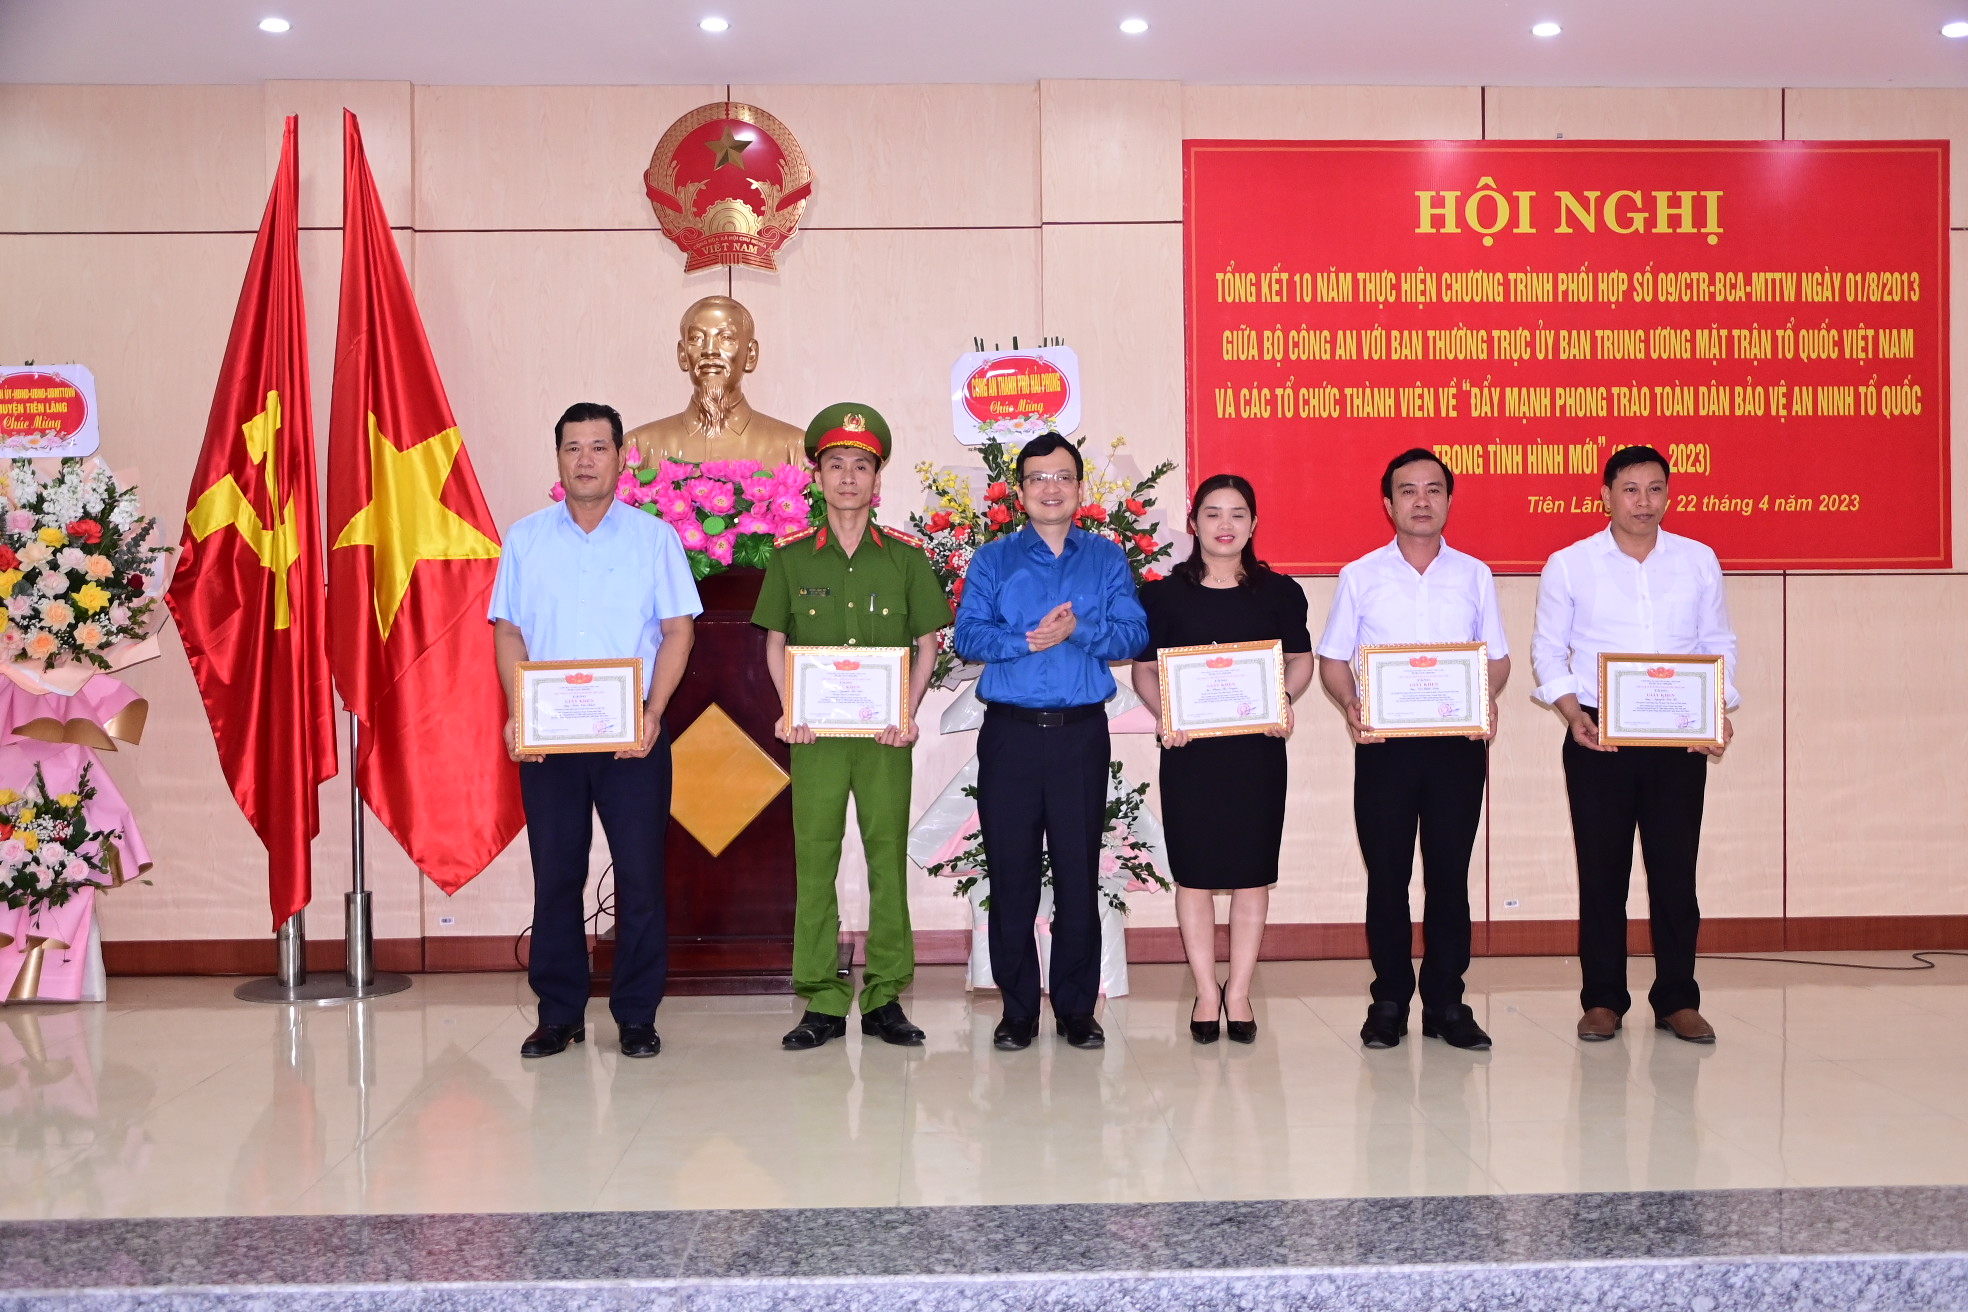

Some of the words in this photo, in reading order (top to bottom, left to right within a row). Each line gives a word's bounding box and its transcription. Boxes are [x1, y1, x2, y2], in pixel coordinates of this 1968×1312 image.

[1414, 176, 1537, 247] HỘI
[1554, 189, 1724, 246] NGHỊ
[733, 242, 759, 254] NAM
[1215, 260, 1257, 304] TỔNG
[1260, 262, 1290, 303] KẾT
[1293, 272, 1313, 303] 10
[1316, 265, 1353, 303] NĂM
[1356, 269, 1397, 309] THỰC
[1400, 265, 1437, 309] HIỆN
[1441, 269, 1504, 303] CHƯƠNG
[1507, 265, 1554, 303] TRÌNH
[1557, 261, 1594, 303] PHỐI
[1597, 269, 1629, 309] HỢP
[1632, 261, 1654, 303] SỐ
[1657, 271, 1797, 303] 09/CTR-BCA-MTTW
[1801, 265, 1842, 303] NGÀY
[1845, 271, 1920, 303] 01/8/2013
[1222, 323, 1259, 361] GIỮA
[1263, 323, 1284, 368] BỘ
[1288, 323, 1331, 361] CÔNG
[1335, 329, 1357, 361] AN
[1360, 323, 1387, 361] VỚI
[1390, 329, 1423, 360] BAN
[1426, 322, 1488, 361] THƯỜNG
[1491, 326, 1531, 367] TRỰC
[1535, 319, 1555, 361] ỦY
[1559, 329, 1591, 360] BAN
[1594, 329, 1645, 360] TRUNG
[1649, 326, 1691, 360] ƯƠNG
[1695, 322, 1728, 366] MẶT
[1731, 322, 1772, 366] TRẬN
[1775, 316, 1795, 360] TỔ
[1798, 318, 1839, 363] QUỐC
[1842, 322, 1875, 366] VIỆT
[1878, 328, 1914, 359] NAM
[971, 374, 989, 397] CÔNG
[988, 375, 998, 396] AN
[997, 372, 1018, 395] THÀNH
[1017, 367, 1031, 395] PHỐ
[1030, 365, 1041, 393] HẢI
[1040, 368, 1062, 392] PHÒNG
[26, 400, 45, 414] TIÊN
[46, 400, 68, 413] LÃNG
[990, 400, 1015, 414] Chúc
[1014, 399, 1044, 413] Mừng
[1214, 381, 1236, 419] VÀ
[1239, 381, 1271, 419] CÁC
[1274, 375, 1295, 419] TỔ
[1298, 380, 1340, 419] CHỨC
[1344, 380, 1395, 418] THÀNH
[1399, 380, 1435, 418] VIÊN
[1438, 377, 1458, 418] VỀ
[1505, 386, 1551, 424] MẠNH
[1555, 386, 1608, 418] PHONG
[1611, 380, 1651, 417] TRÀO
[1654, 379, 1695, 417] TOÀN
[1698, 379, 1730, 416] DÂN
[1734, 375, 1765, 417] BẢO
[1768, 379, 1788, 423] VỆ
[1791, 386, 1813, 416] AN
[1817, 386, 1855, 416] NINH
[1858, 373, 1877, 416] TỔ
[1881, 374, 1922, 419] QUỐC
[4, 415, 30, 429] Chúc
[30, 414, 62, 430] Mừng
[1432, 443, 1484, 475] TRONG
[1487, 437, 1523, 475] TÌNH
[1527, 437, 1564, 475] HÌNH
[1668, 443, 1711, 476] 2023)
[1527, 495, 1564, 513] Tiên
[1676, 494, 1697, 512] 22
[1702, 494, 1754, 516] tháng
[1758, 494, 1769, 512] 4
[1774, 494, 1813, 512] năm
[1818, 494, 1860, 511] 2023
